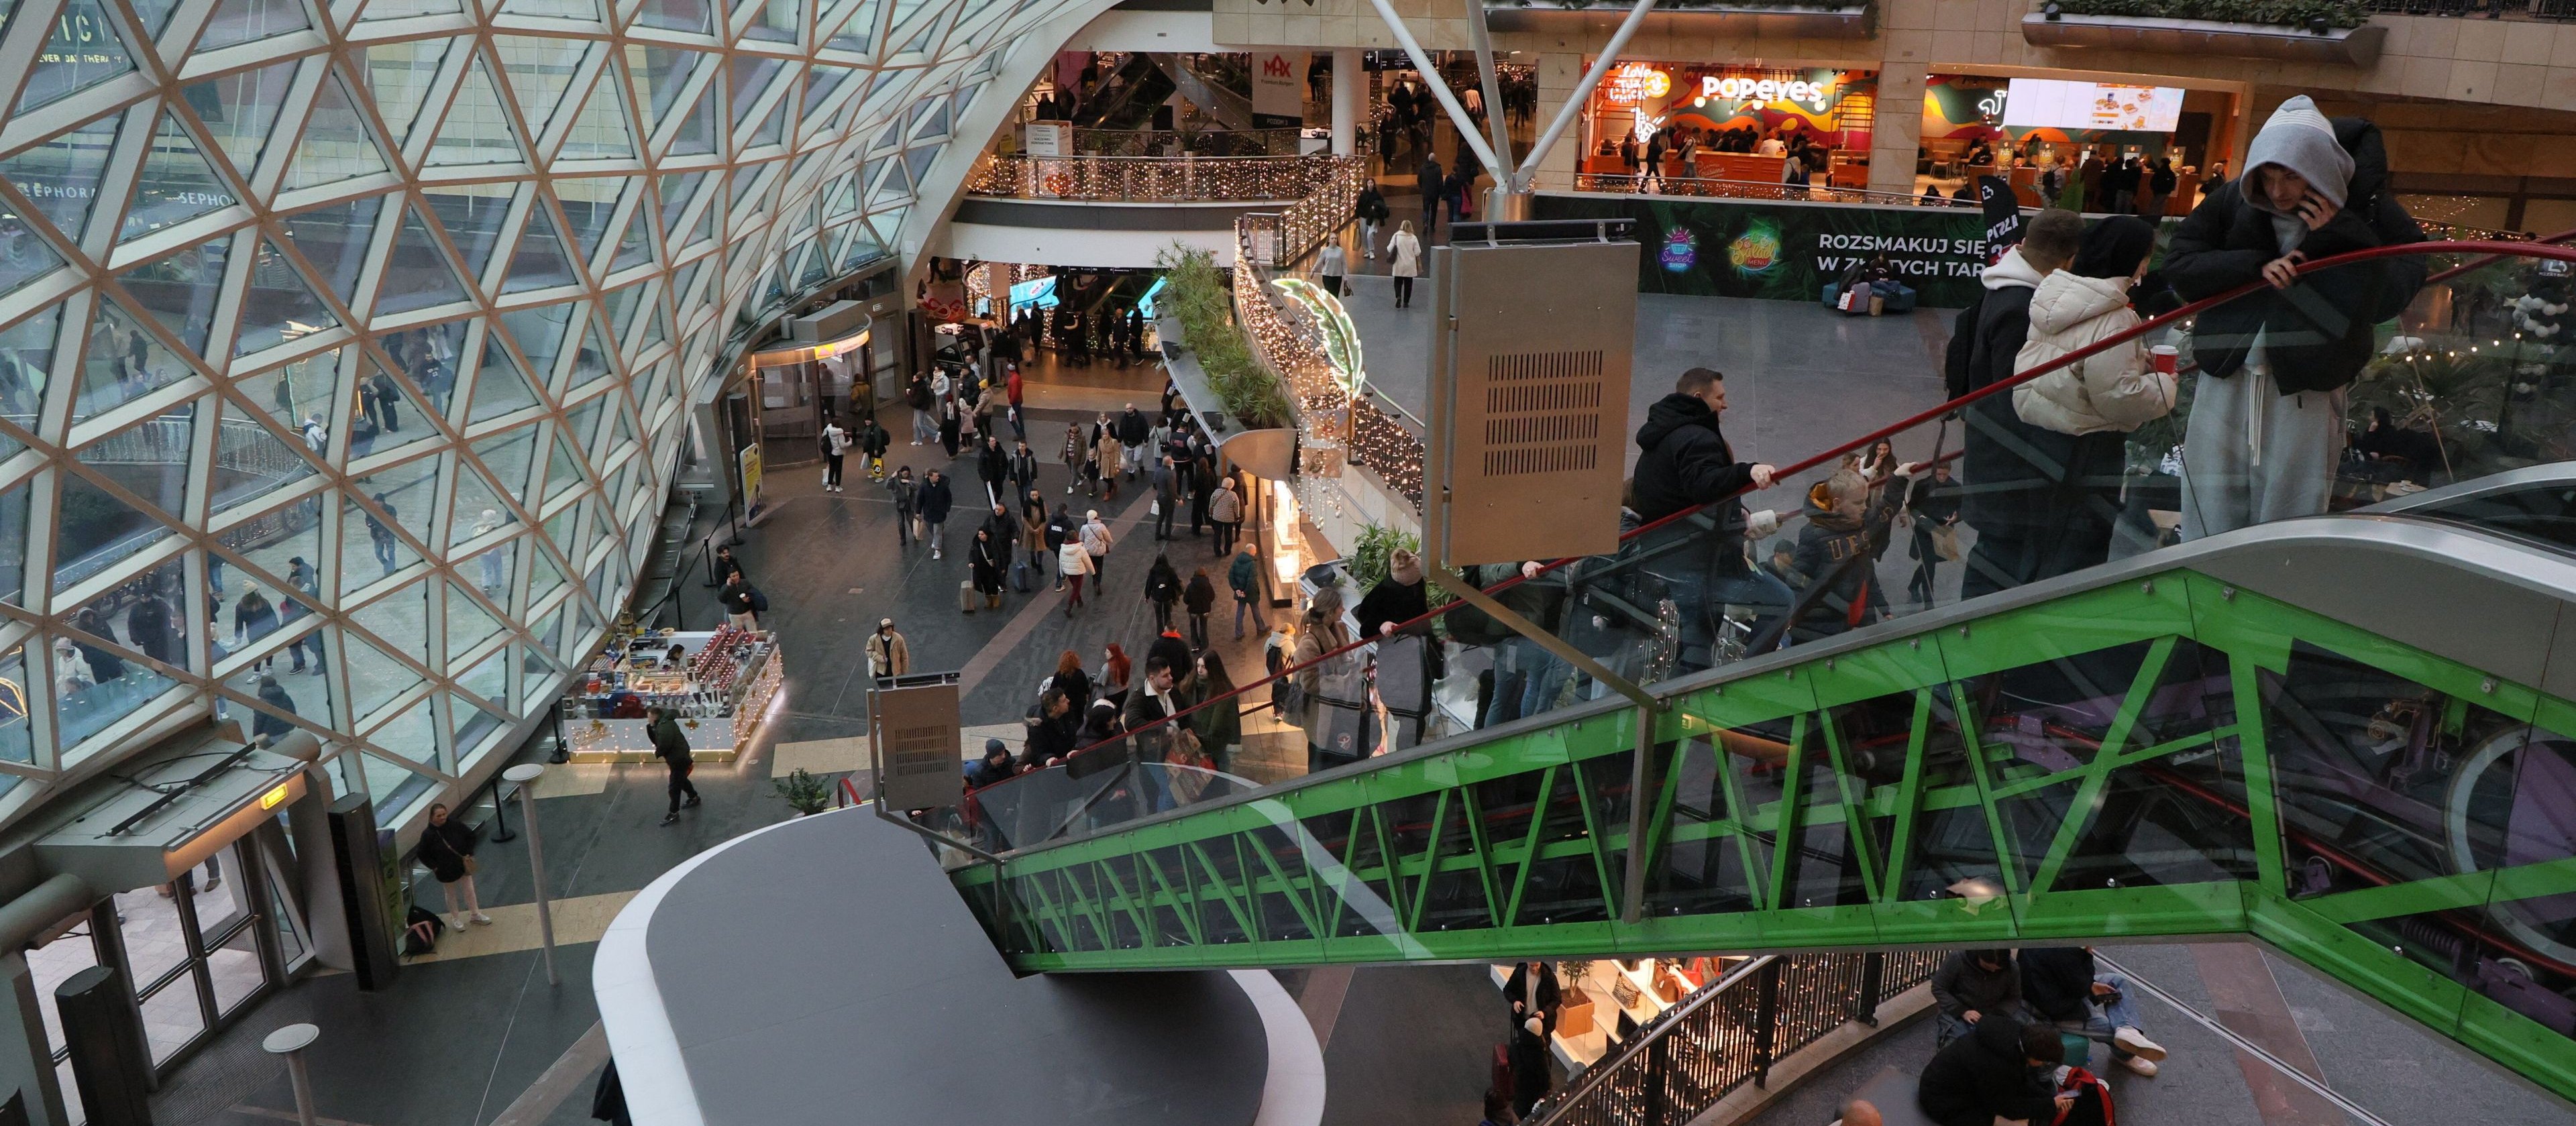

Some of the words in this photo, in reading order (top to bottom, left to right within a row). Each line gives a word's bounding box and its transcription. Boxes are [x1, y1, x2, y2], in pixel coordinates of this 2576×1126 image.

[84, 54, 122, 63] THERAY
[1264, 54, 1291, 78] MAX
[23, 186, 96, 199] SEPHOR
[179, 192, 235, 207] SEPHO
[1986, 214, 2019, 243] PIZZA
[1819, 233, 1948, 254] ROZSMAKUJ
[1953, 239, 1987, 260] SIĘ
[1662, 250, 1695, 264] Sweet
[1817, 256, 1839, 271] W
